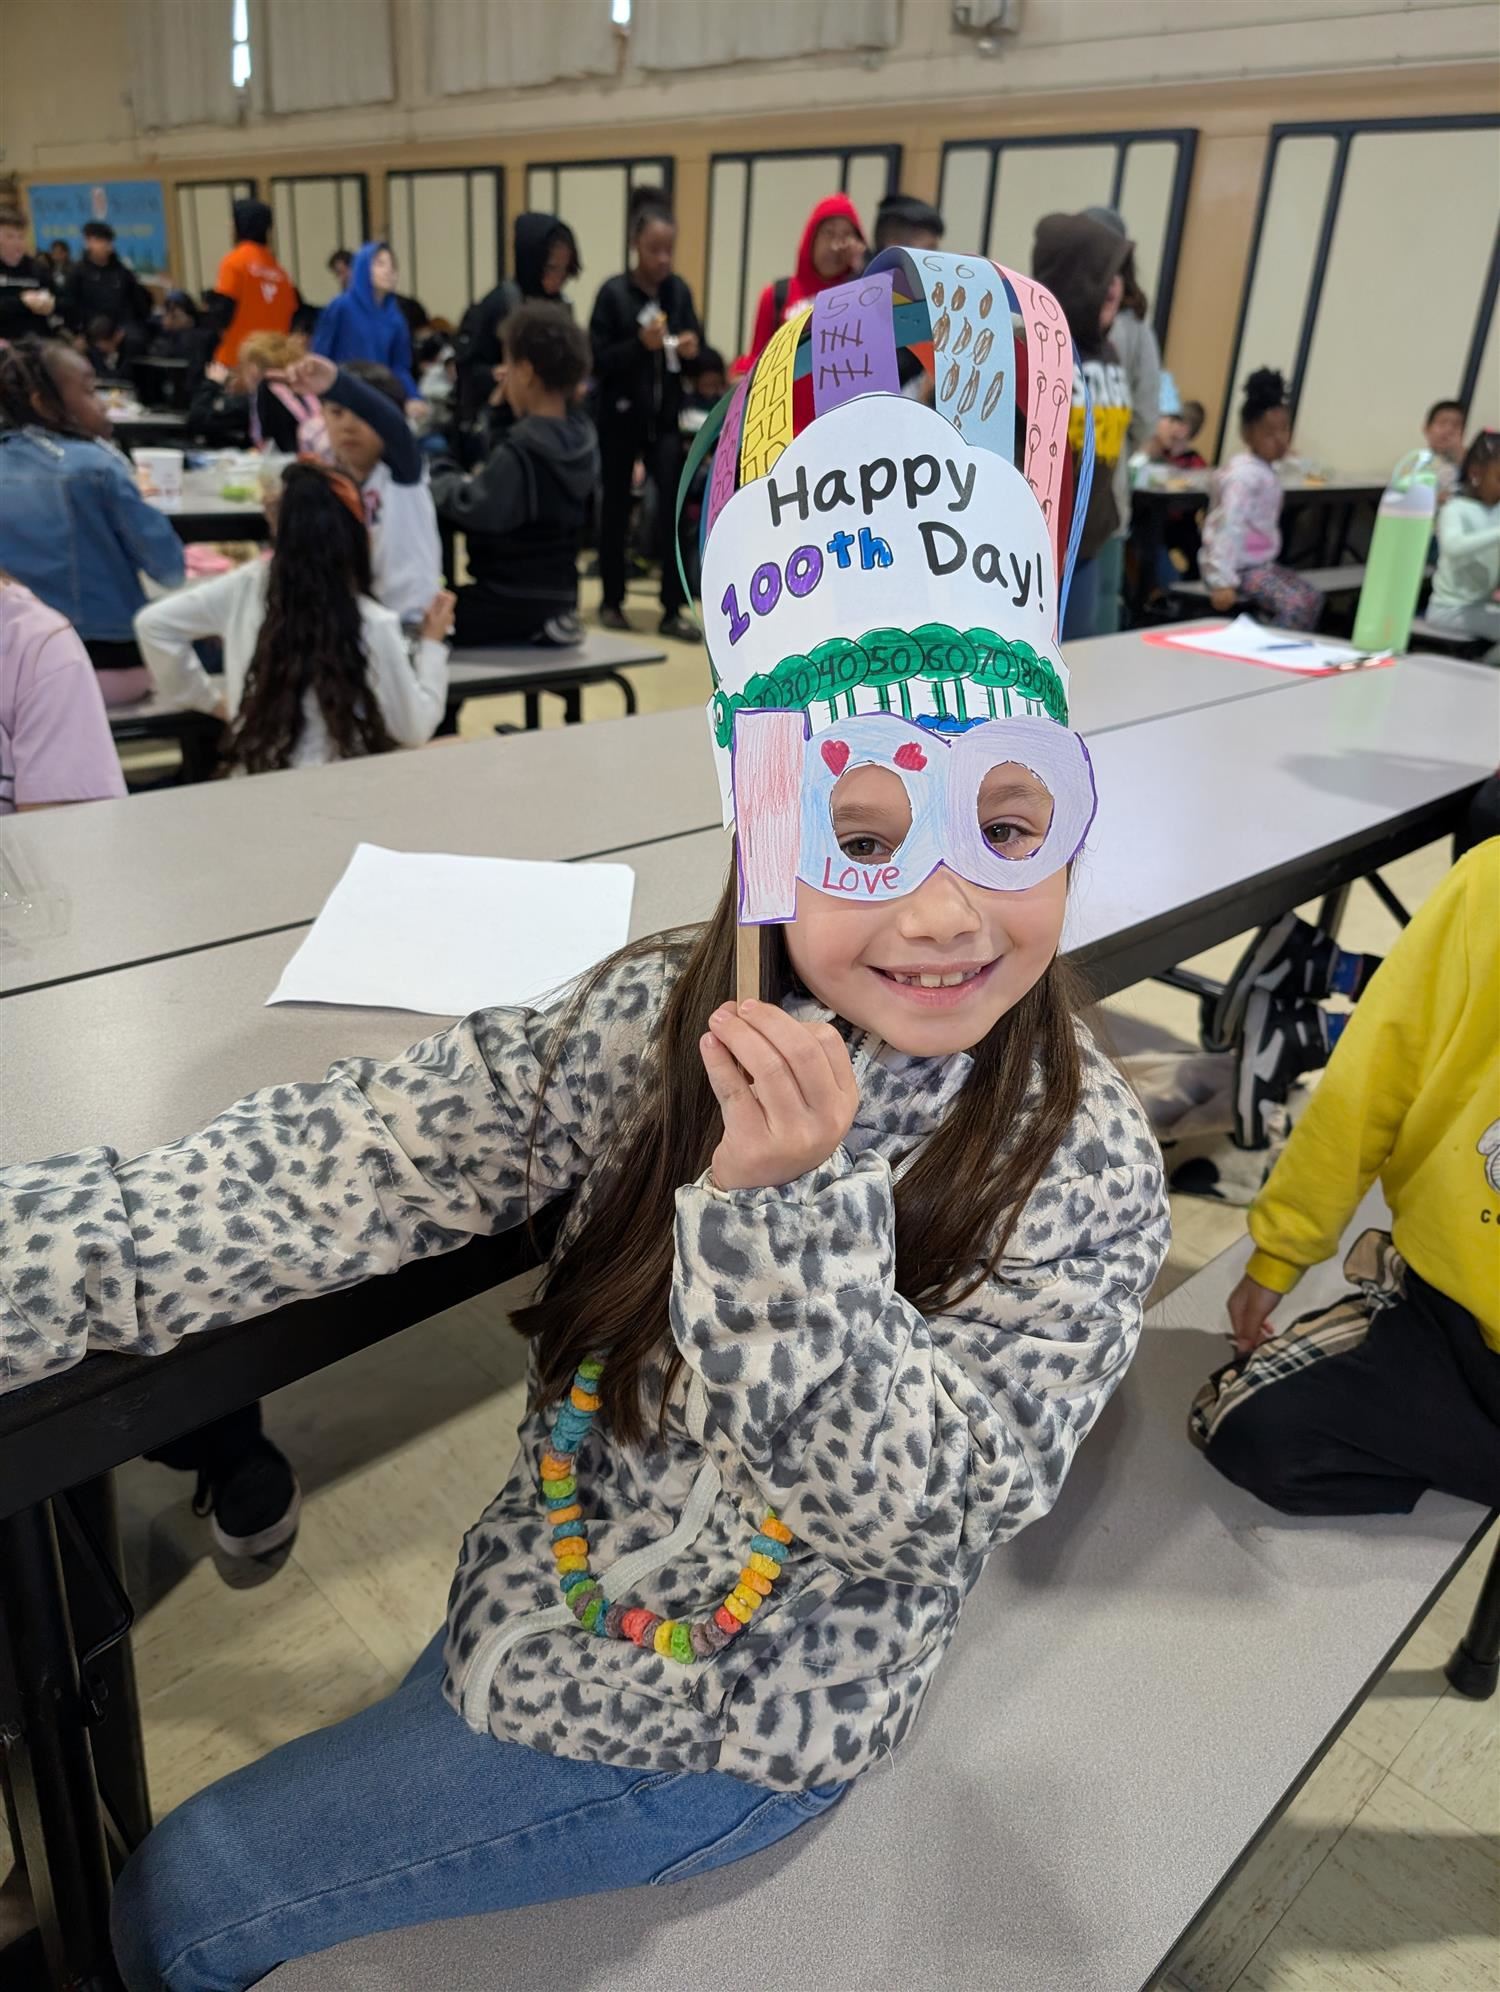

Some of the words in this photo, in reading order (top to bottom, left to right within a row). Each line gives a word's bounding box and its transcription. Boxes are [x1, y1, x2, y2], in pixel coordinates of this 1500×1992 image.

[820, 285, 884, 320] 50
[767, 453, 977, 528] Happy
[720, 526, 894, 646] 100th
[917, 521, 1045, 613] Day!
[780, 670, 811, 707] 30
[820, 654, 858, 687] 40
[869, 645, 912, 675] 50
[924, 643, 969, 674] 60
[975, 643, 1012, 680] 70
[1020, 657, 1043, 693] 80
[822, 856, 900, 895] Love
